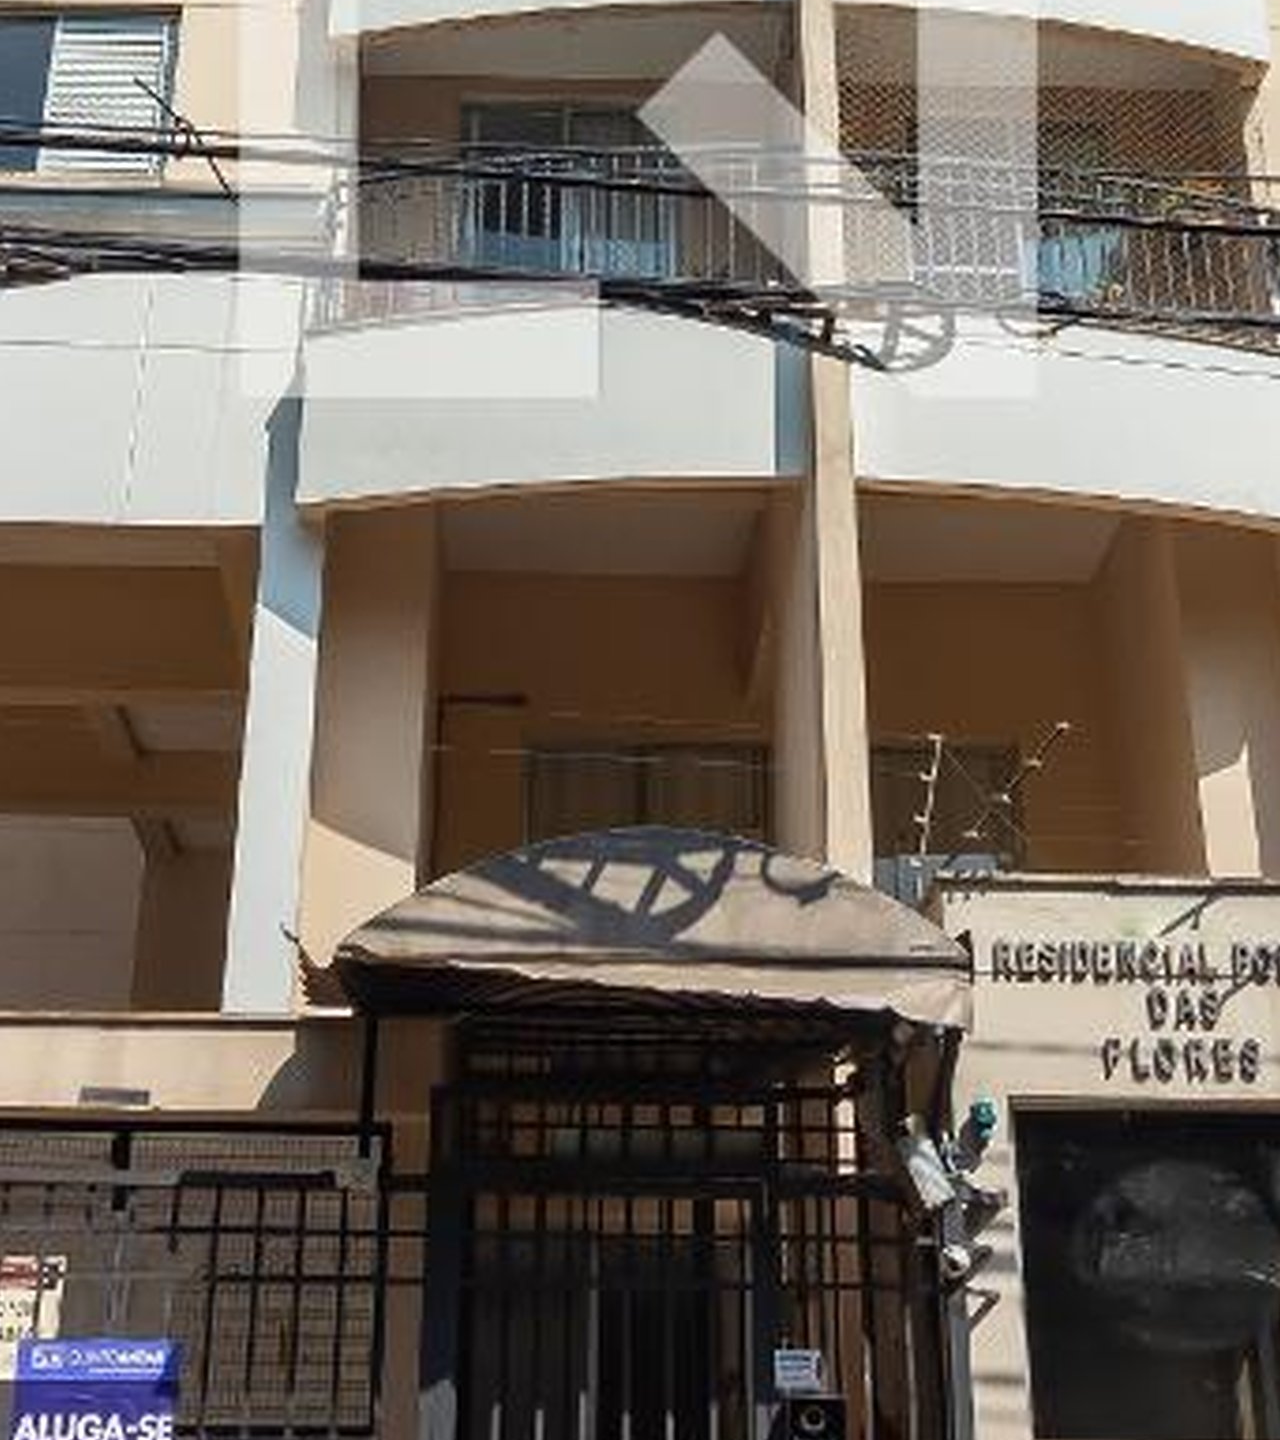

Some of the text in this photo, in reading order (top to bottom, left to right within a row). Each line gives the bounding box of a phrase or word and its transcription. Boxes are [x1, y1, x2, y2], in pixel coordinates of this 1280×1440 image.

[991, 940, 1220, 987] RESIDENCIAL
[1145, 989, 1220, 1032] DAS
[1100, 1036, 1261, 1084] FLORES
